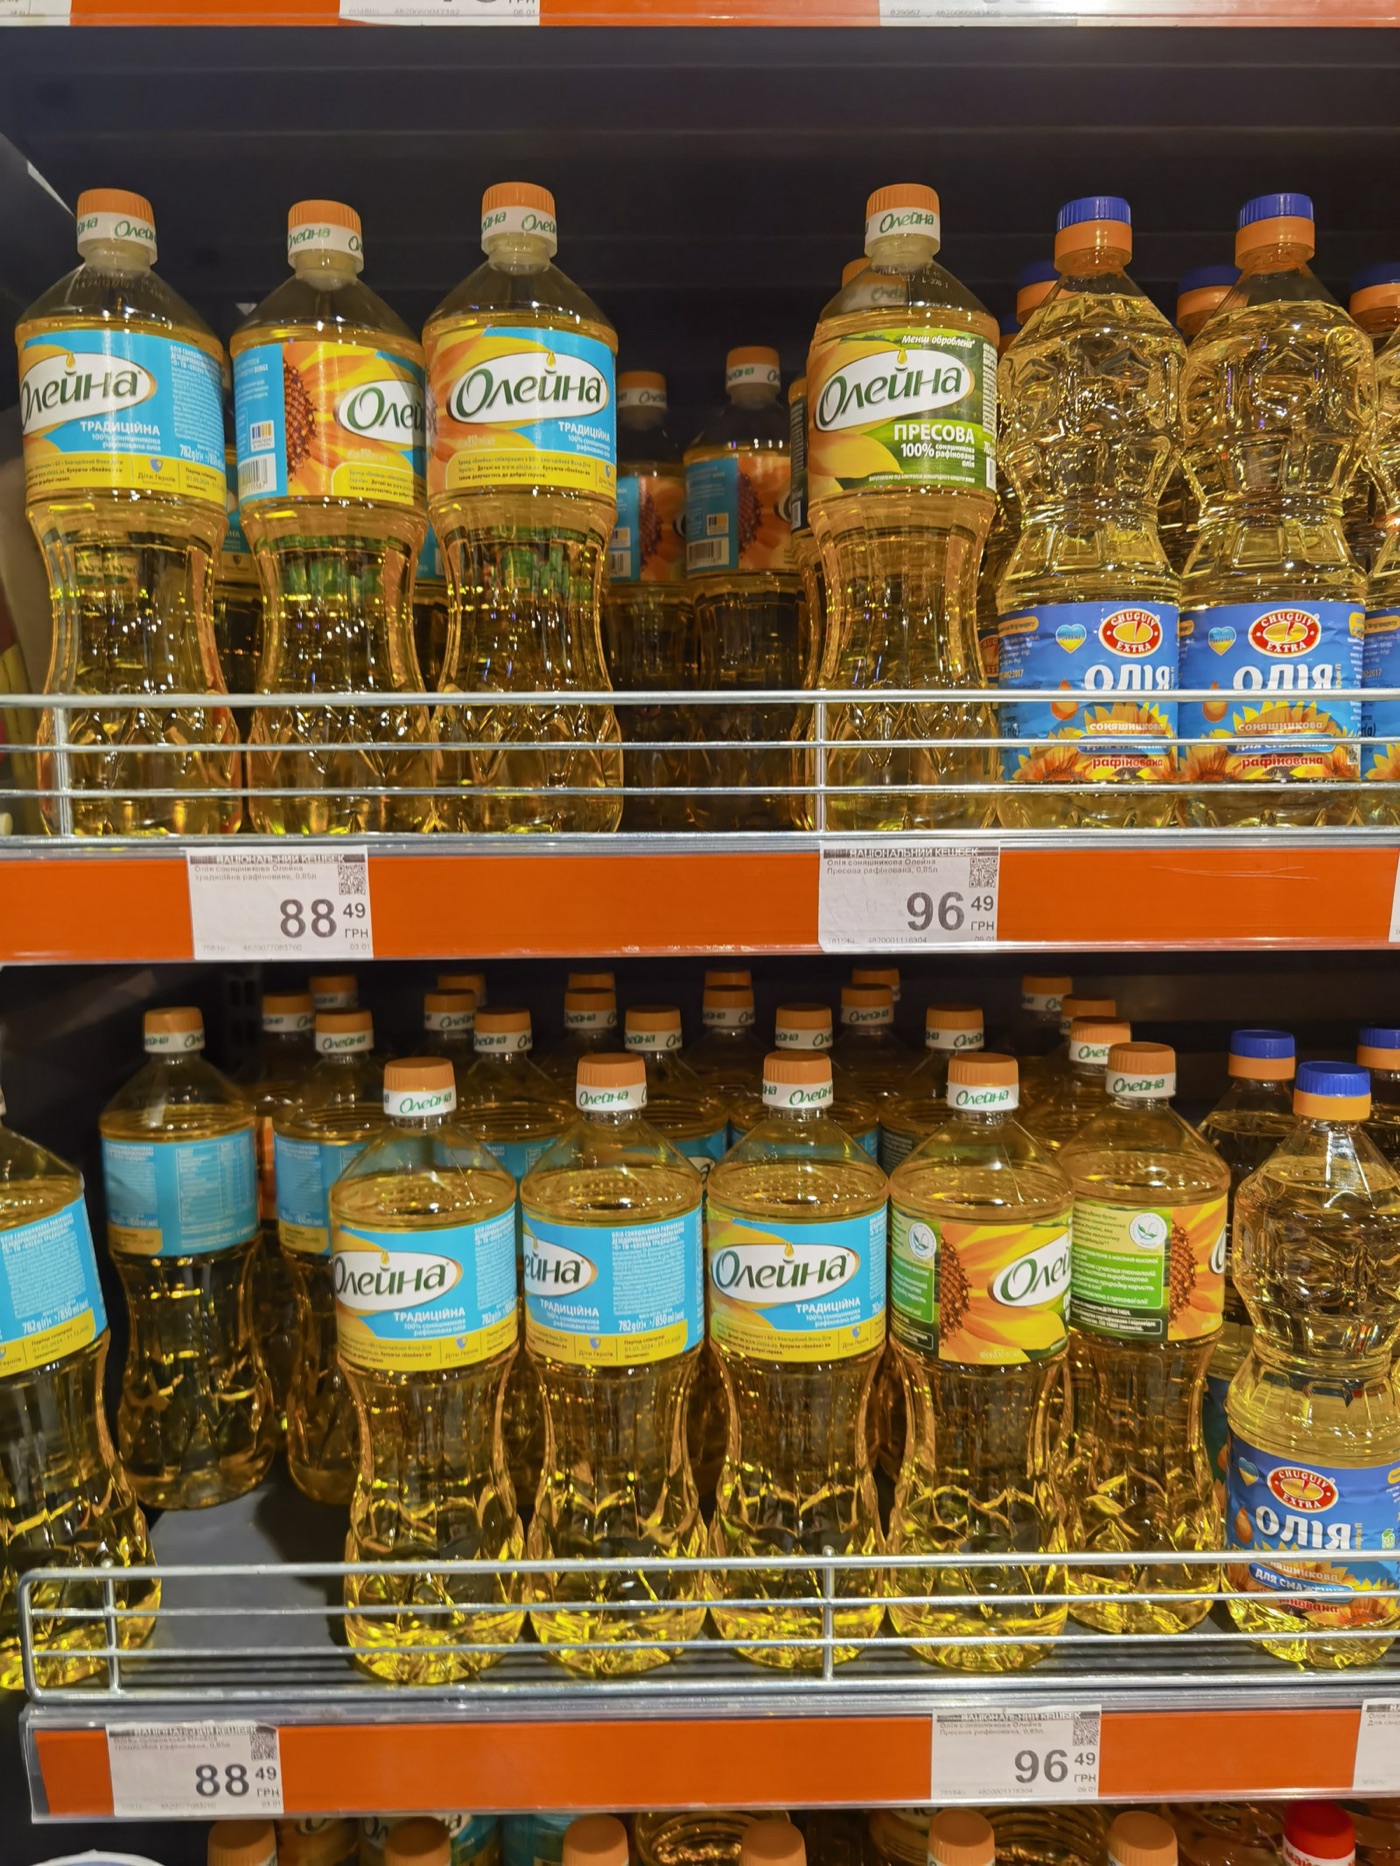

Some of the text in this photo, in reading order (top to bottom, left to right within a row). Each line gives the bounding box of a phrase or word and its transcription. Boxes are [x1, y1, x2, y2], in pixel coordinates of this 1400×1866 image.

[880, 211, 934, 233] Олейна
[901, 334, 930, 344] Менш
[456, 367, 603, 418] Олейна
[818, 366, 963, 427] Олейна
[80, 420, 160, 437] ТРАДИЦІЙНА
[558, 421, 611, 443] ТРАДИЦІЙНА
[894, 424, 975, 444] ПРЕСОВА
[901, 443, 975, 458] 100% соняшникова
[935, 450, 975, 461] рафінована
[962, 460, 975, 468] олія
[1110, 612, 1157, 627] CHUGUIV
[1260, 612, 1315, 627] CHUGUIV
[1115, 642, 1152, 653] EXTRA
[1265, 642, 1308, 654] EXTRA
[1238, 721, 1324, 732] соняшникова
[1092, 755, 1163, 769] рафінована
[1241, 755, 1324, 770] рафінована
[850, 847, 979, 858] НАЦІОНАЛЬНИЙ КЕШБЕК
[905, 857, 936, 865] Олейна
[827, 867, 861, 875] Пресова
[343, 902, 366, 918] 49
[906, 891, 965, 932] 96
[970, 895, 994, 912] 49
[280, 898, 337, 938] 88
[970, 921, 995, 931] ГРН
[344, 928, 369, 938] ГРН
[322, 1034, 366, 1050] Олейна
[1112, 1078, 1165, 1093] Олейна
[400, 1092, 452, 1114] Олейна
[578, 1091, 629, 1107] Олейна
[956, 1088, 1009, 1106] Олейна
[334, 1256, 447, 1296] Олейна
[716, 1250, 847, 1289] Олейна
[540, 1299, 600, 1317] ТРАДИЦІЙНА
[795, 1297, 861, 1314] ТРАДИЦІЙНА
[393, 1307, 466, 1323] ТРАДИЦІЙНА
[806, 1313, 822, 1321] 100%
[404, 1322, 421, 1330] 100%
[1278, 1470, 1329, 1490] CHUGUIV
[1281, 1493, 1322, 1509] EXTRA
[1255, 1505, 1352, 1550] ОЛІЯ
[1014, 1749, 1069, 1784] 96
[1074, 1752, 1096, 1766] 49
[195, 1764, 250, 1797] 88
[255, 1766, 277, 1780] 49
[1074, 1774, 1097, 1783] ГРН
[256, 1787, 280, 1797] ГРН
